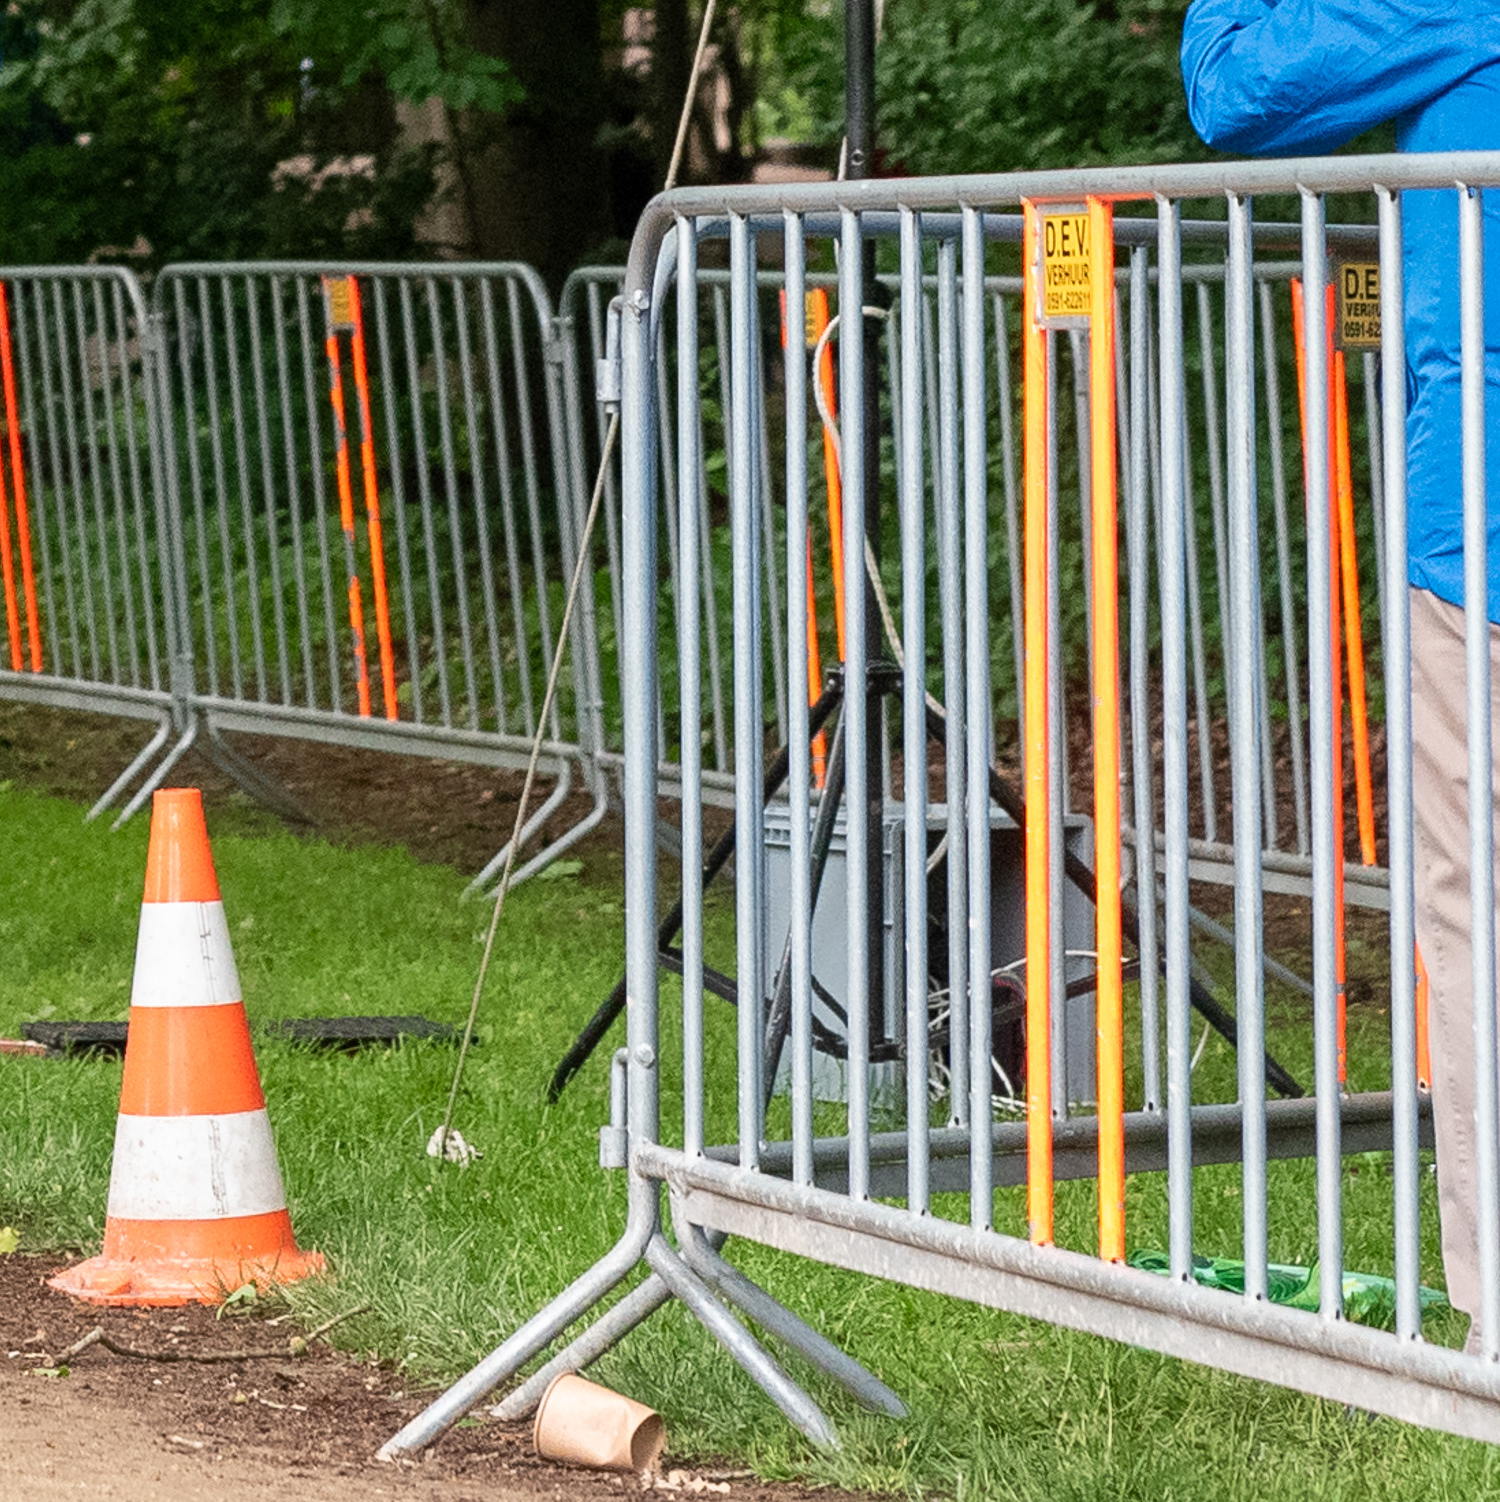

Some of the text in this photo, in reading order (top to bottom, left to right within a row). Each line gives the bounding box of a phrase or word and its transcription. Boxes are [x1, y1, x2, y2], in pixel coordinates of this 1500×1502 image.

[1045, 219, 1089, 258] D.E.V.
[1046, 263, 1090, 286] VERHUUR
[1345, 268, 1378, 300] D.E
[1344, 320, 1381, 339] 0591-62
